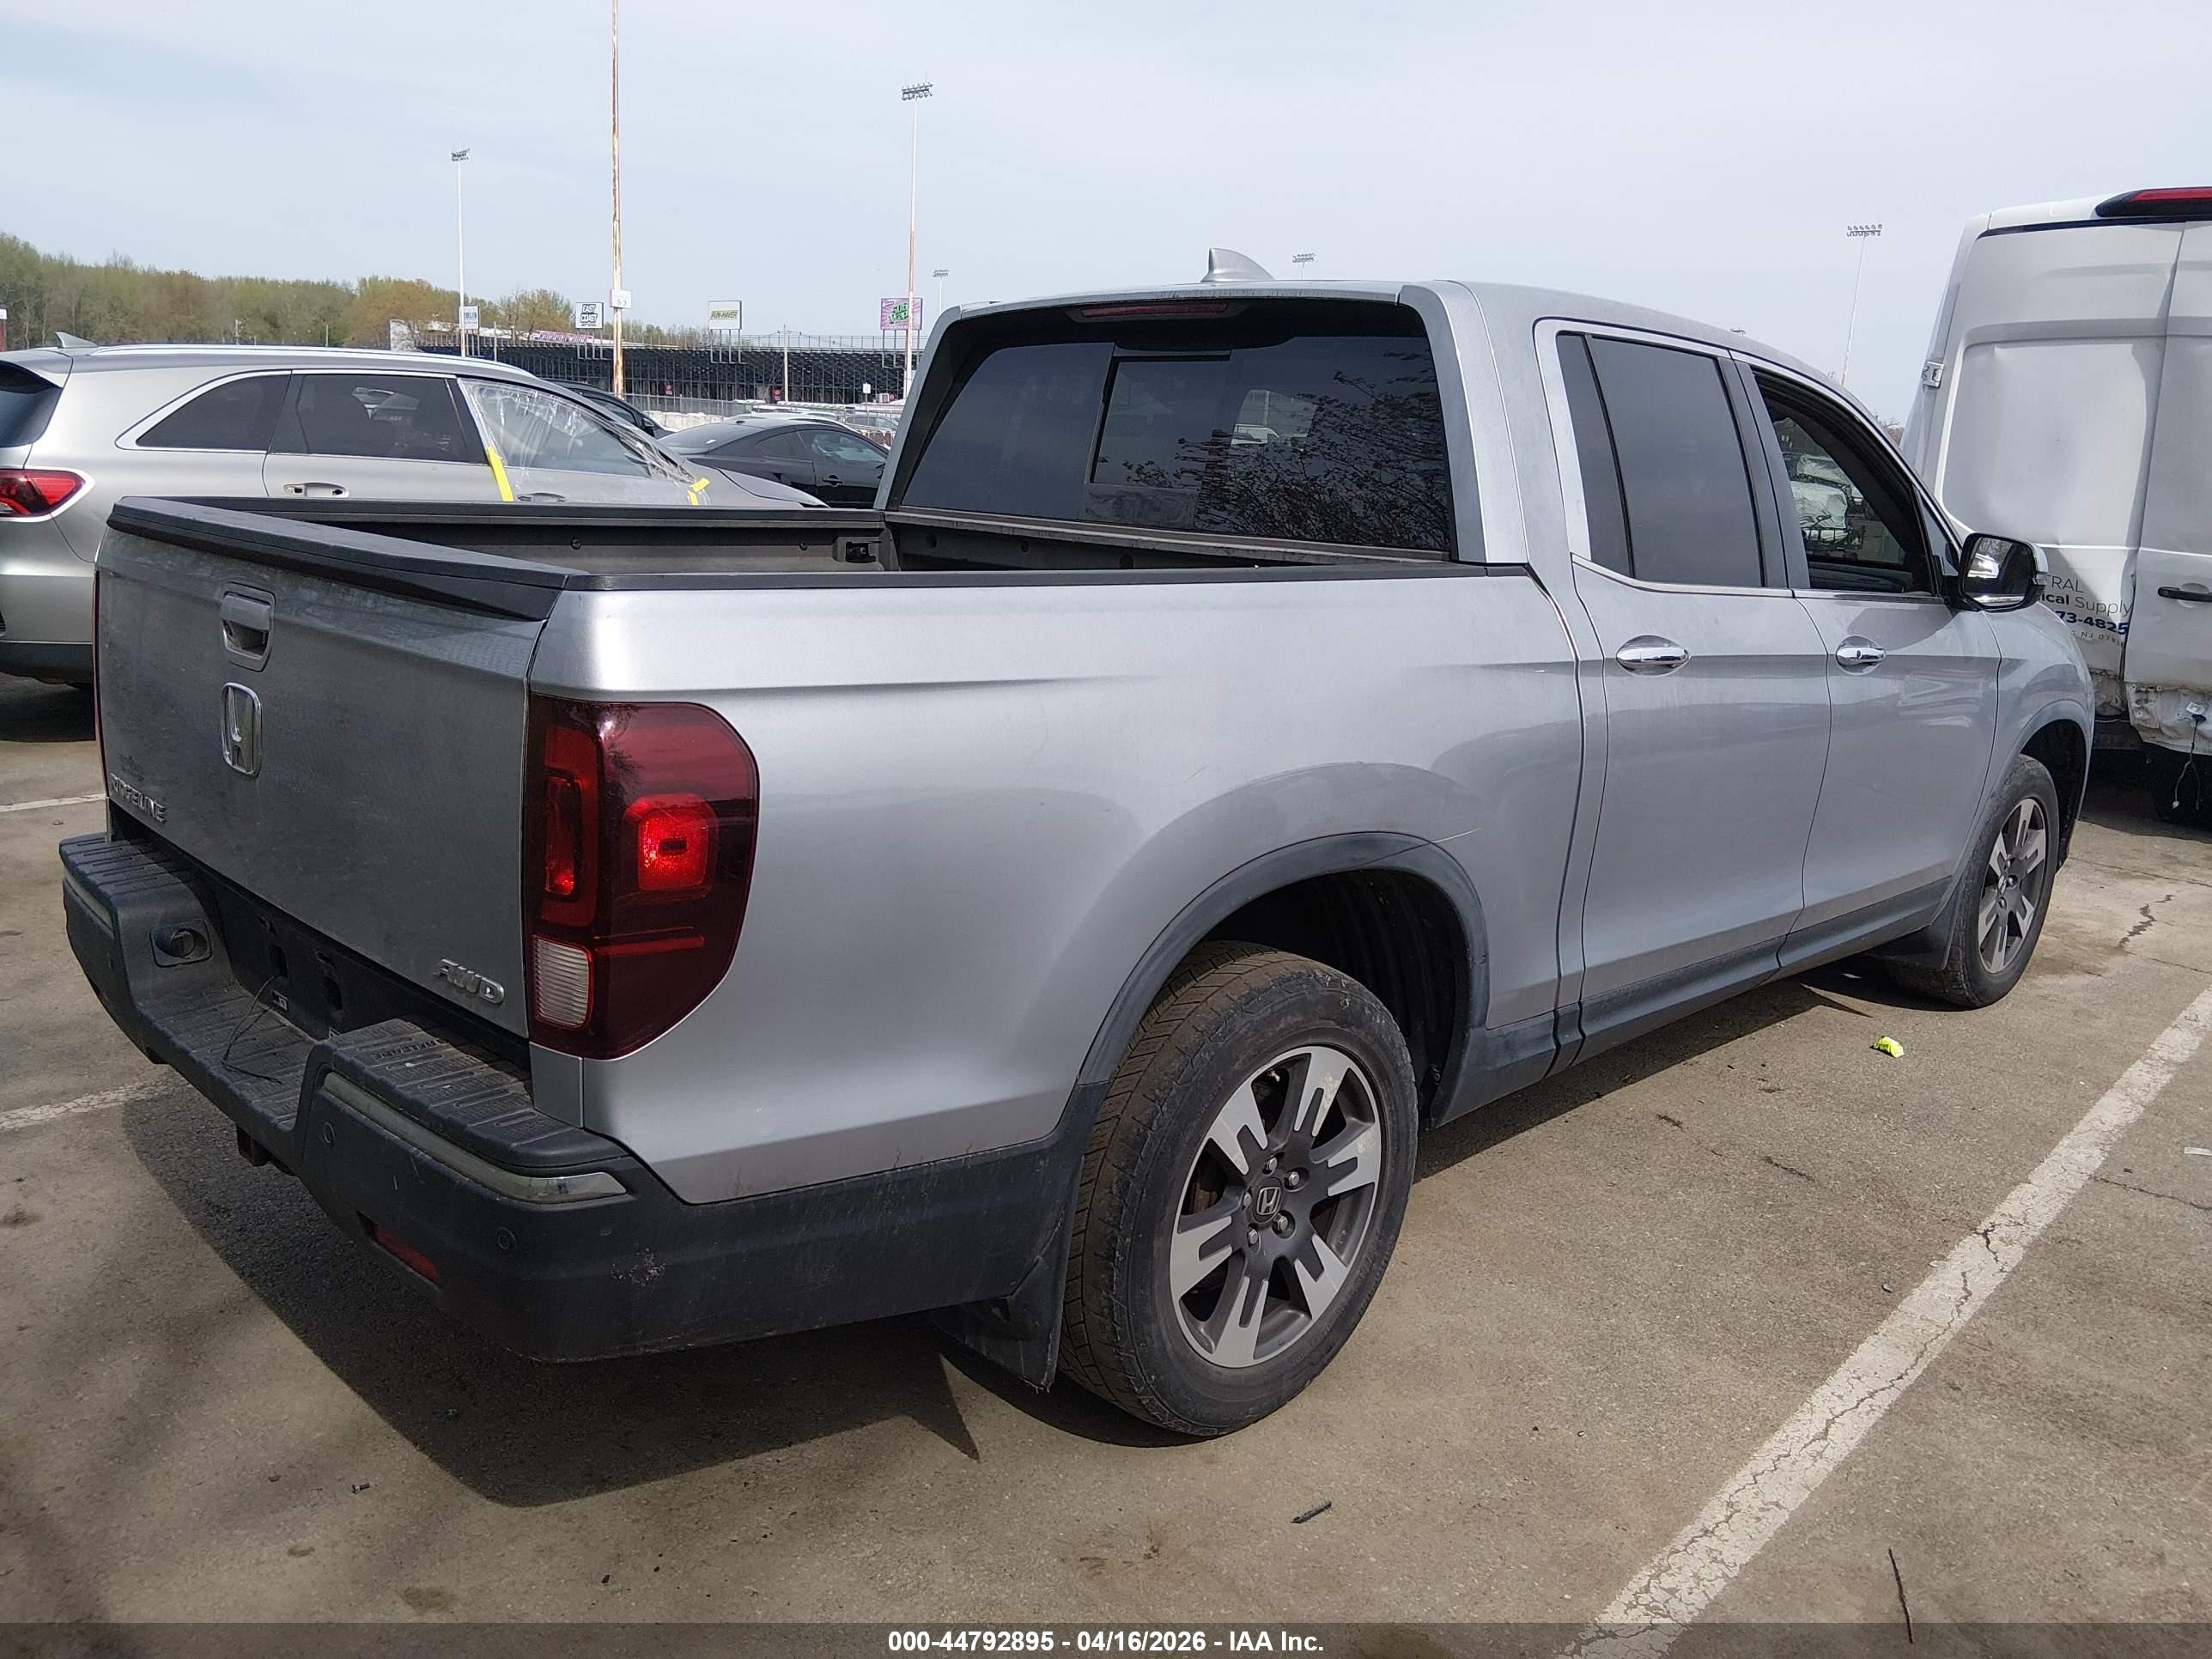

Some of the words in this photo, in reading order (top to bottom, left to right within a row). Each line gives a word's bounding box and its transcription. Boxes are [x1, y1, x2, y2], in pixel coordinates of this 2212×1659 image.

[582, 304, 596, 313] EAST
[580, 313, 598, 323] COAST
[2075, 596, 2134, 617] Supply
[434, 958, 505, 1004] AWD
